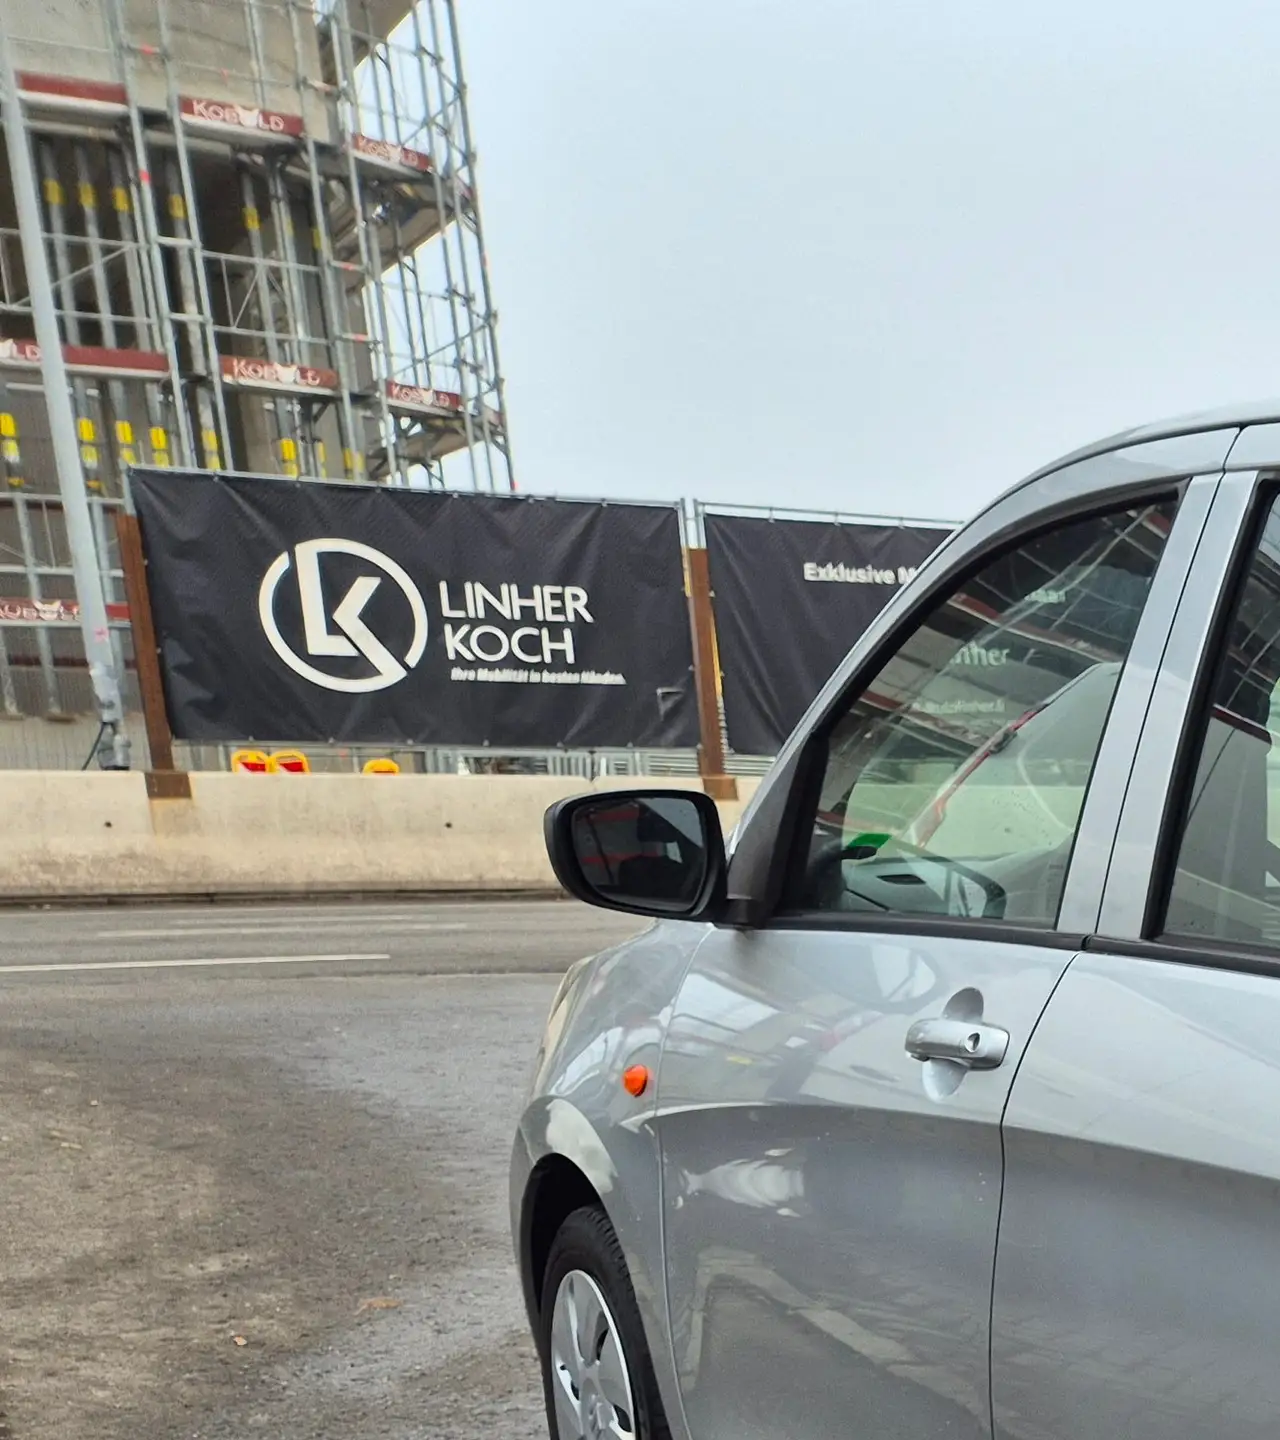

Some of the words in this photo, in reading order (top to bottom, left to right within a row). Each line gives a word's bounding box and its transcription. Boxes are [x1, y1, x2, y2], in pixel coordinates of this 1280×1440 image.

[803, 562, 895, 584] Exklusive
[439, 580, 594, 623] LINHER
[444, 623, 575, 664] KOCH
